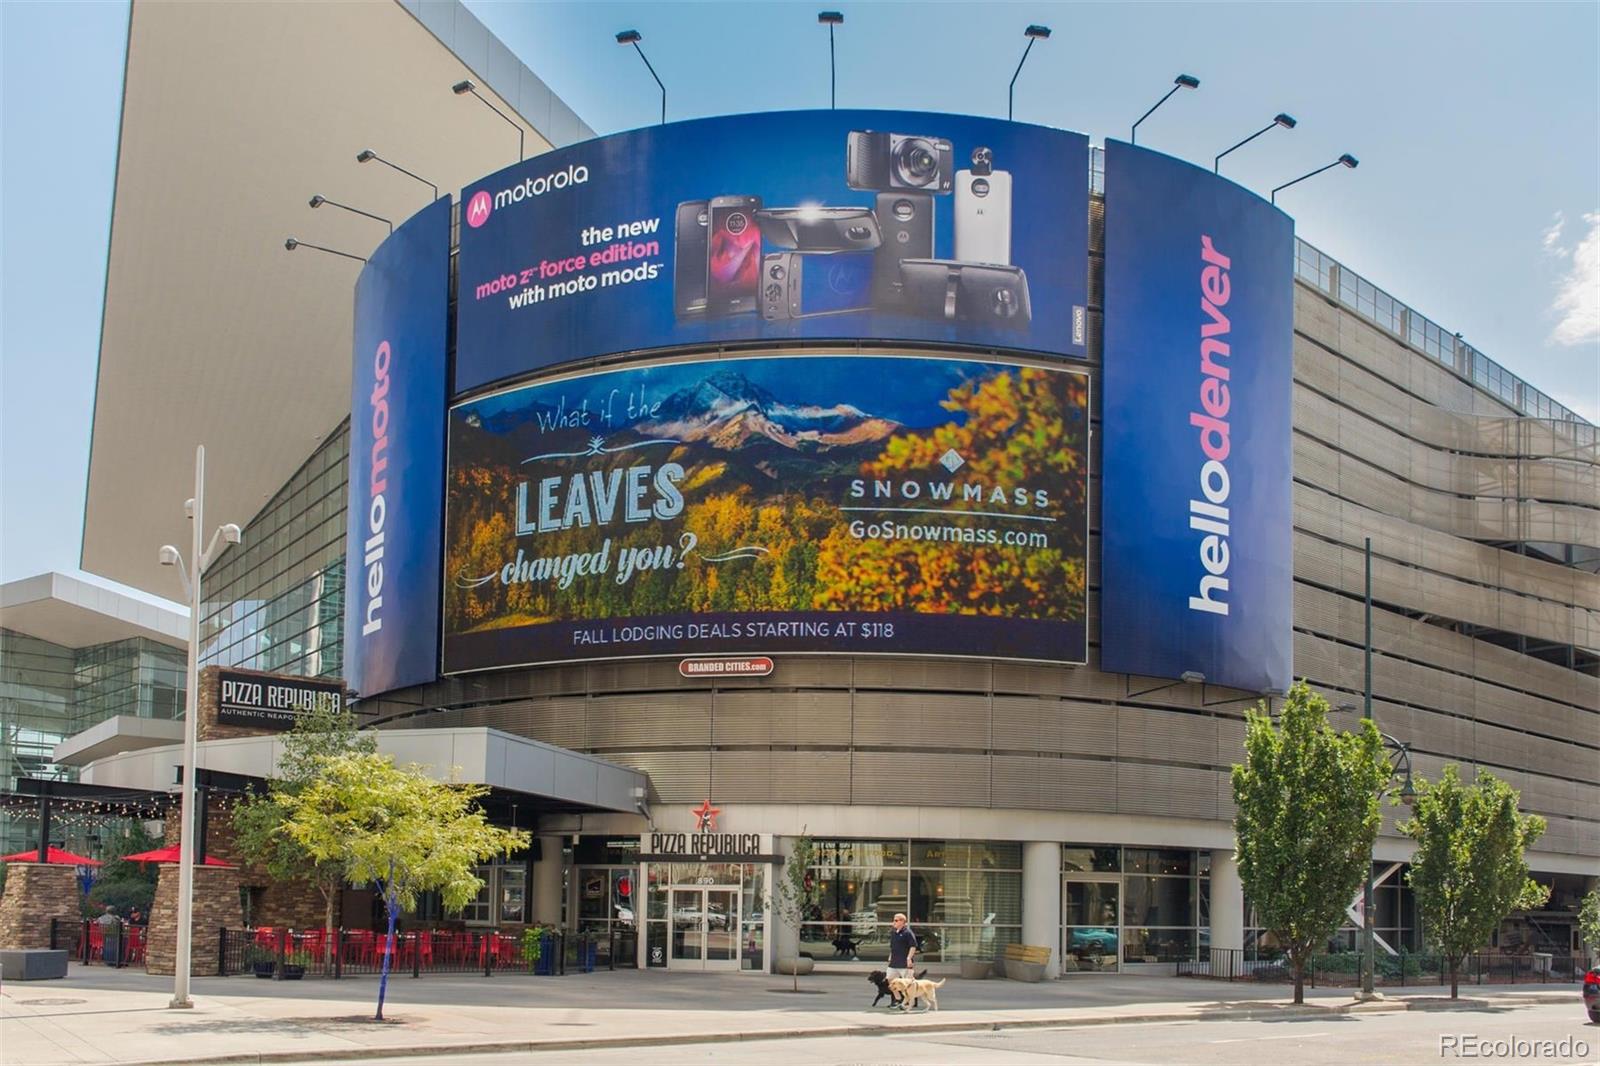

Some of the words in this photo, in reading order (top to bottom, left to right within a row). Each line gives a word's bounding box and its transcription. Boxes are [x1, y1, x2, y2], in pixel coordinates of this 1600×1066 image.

[494, 164, 589, 211] motorola
[581, 226, 613, 246] the
[617, 218, 660, 239] new
[476, 273, 517, 300] moto
[539, 254, 586, 280] force
[590, 240, 659, 266] edition
[508, 284, 545, 310] with
[548, 274, 598, 299] moto
[536, 394, 592, 435] What
[600, 387, 619, 429] if
[626, 384, 662, 420] the
[514, 462, 686, 537] LEAVES
[850, 479, 1050, 508] SNOWMASS
[849, 519, 1049, 548] GoSnowmass.com
[500, 538, 611, 591] changed
[616, 532, 698, 585] you?
[573, 630, 608, 645] FALL
[612, 624, 684, 643] LODGING
[687, 623, 742, 639] DEALS
[746, 621, 830, 638] STARTING
[834, 622, 857, 637] AT
[861, 622, 895, 639] $118
[687, 662, 724, 673] BRANDED
[725, 661, 767, 672] CITIES.com
[222, 680, 262, 706] PIZZA
[267, 685, 341, 714] REPUBLICA
[221, 708, 264, 718] AUTHENTIC
[651, 833, 685, 854] PIZZA
[691, 834, 760, 854] REPUBLICA
